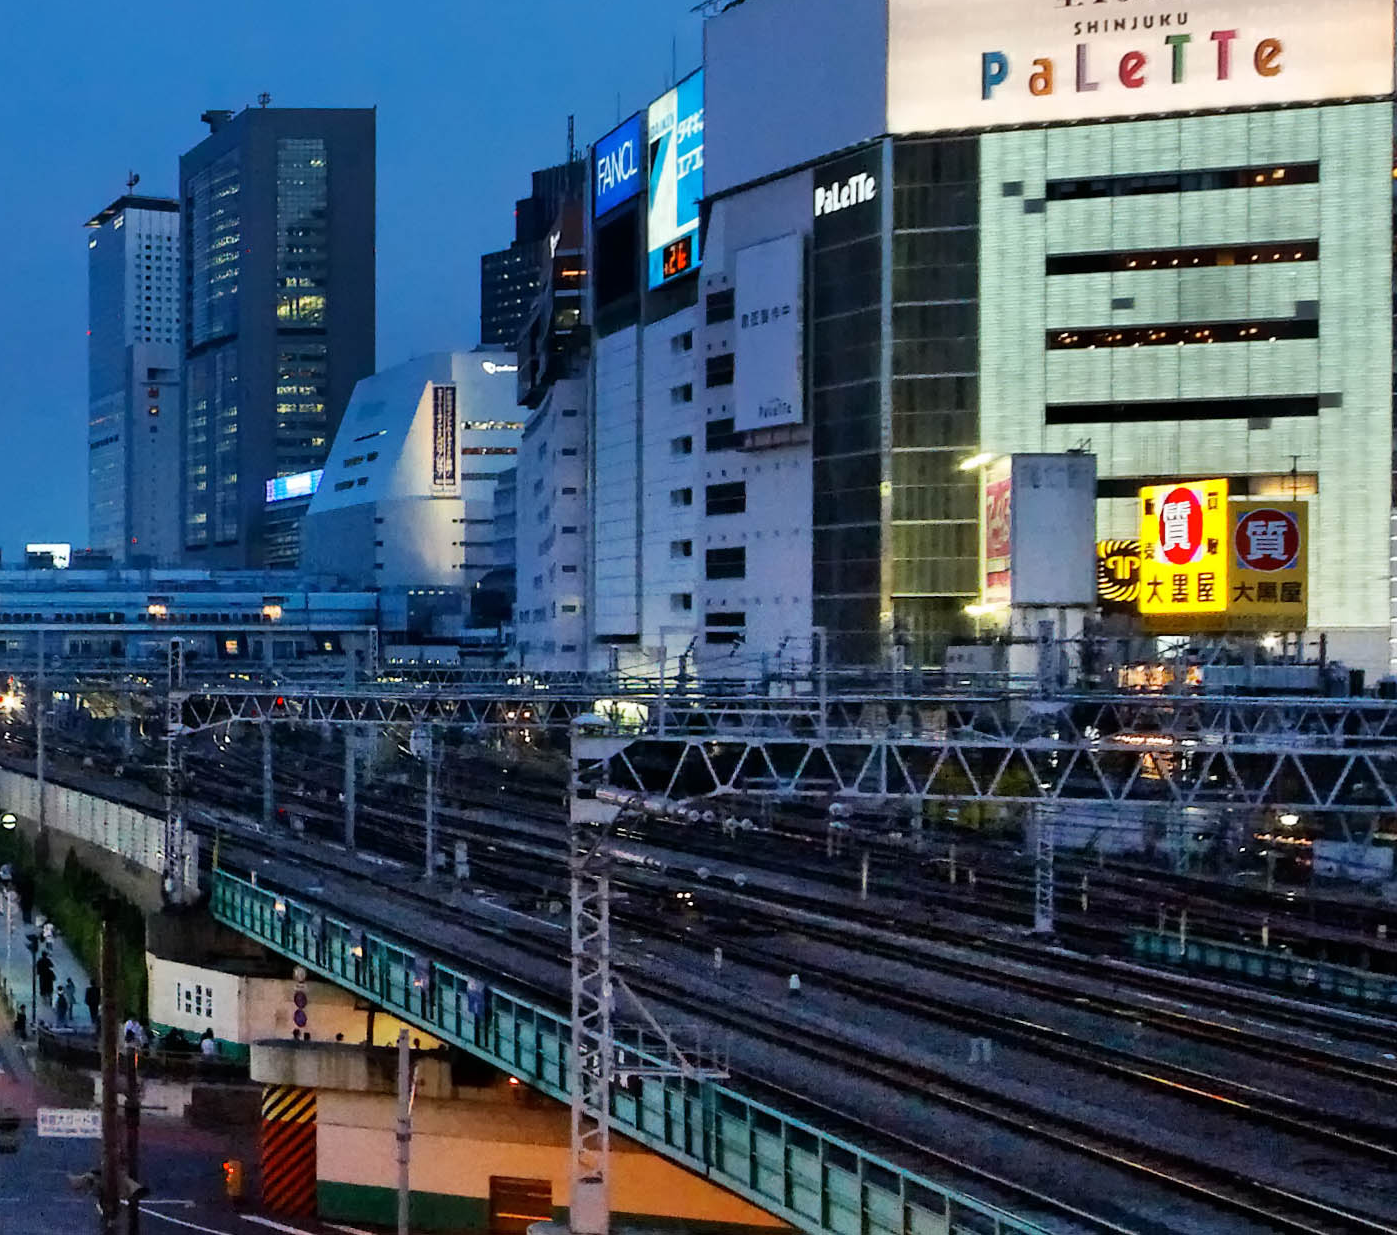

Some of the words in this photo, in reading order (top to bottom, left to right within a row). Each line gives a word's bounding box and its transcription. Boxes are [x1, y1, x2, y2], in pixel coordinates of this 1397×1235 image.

[1074, 12, 1189, 36] SHINJUKU
[597, 139, 637, 196] FANCL
[1162, 500, 1192, 552] 質
[1246, 520, 1289, 561] 質
[1147, 571, 1216, 604] 大黒屋
[1233, 581, 1302, 604] 大黒屋
